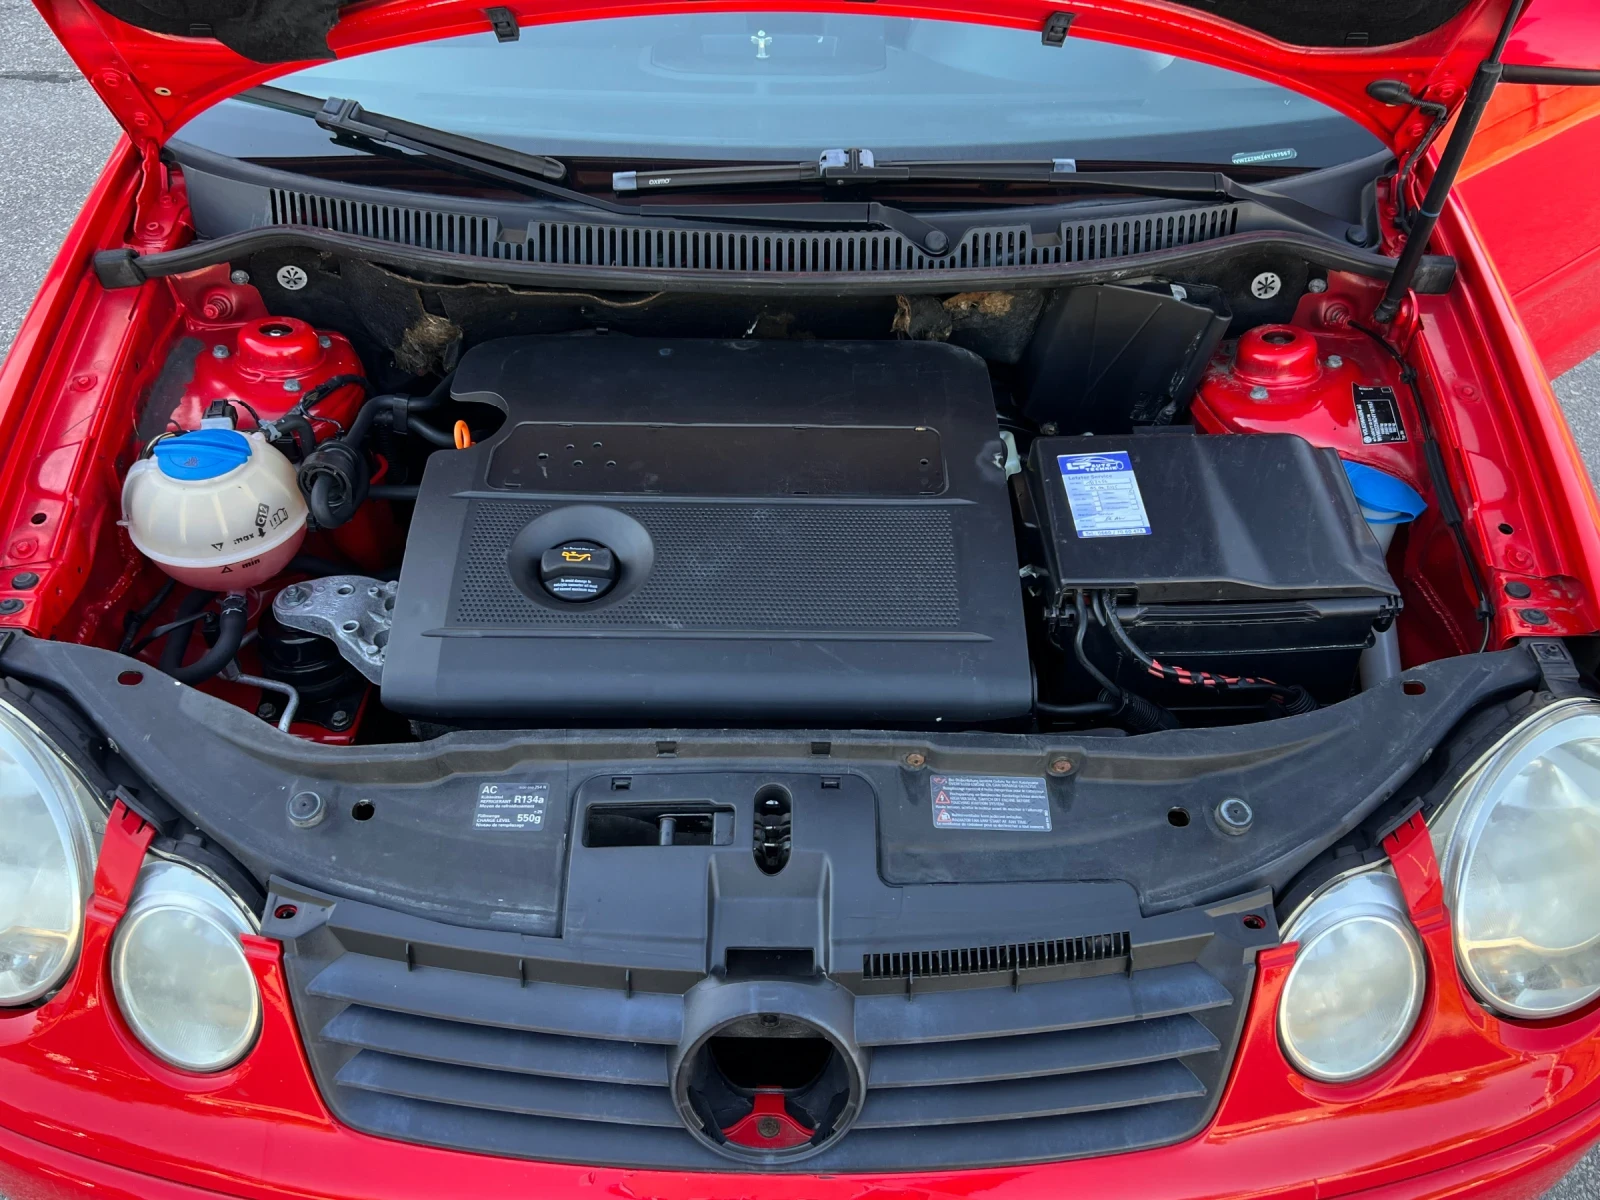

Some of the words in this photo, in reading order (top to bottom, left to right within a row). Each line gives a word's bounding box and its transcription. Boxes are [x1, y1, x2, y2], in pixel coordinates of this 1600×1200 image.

[233, 533, 254, 544] max
[242, 558, 260, 568] min
[482, 786, 498, 794] AC
[514, 795, 545, 804] R134a
[517, 814, 541, 824] 550g
